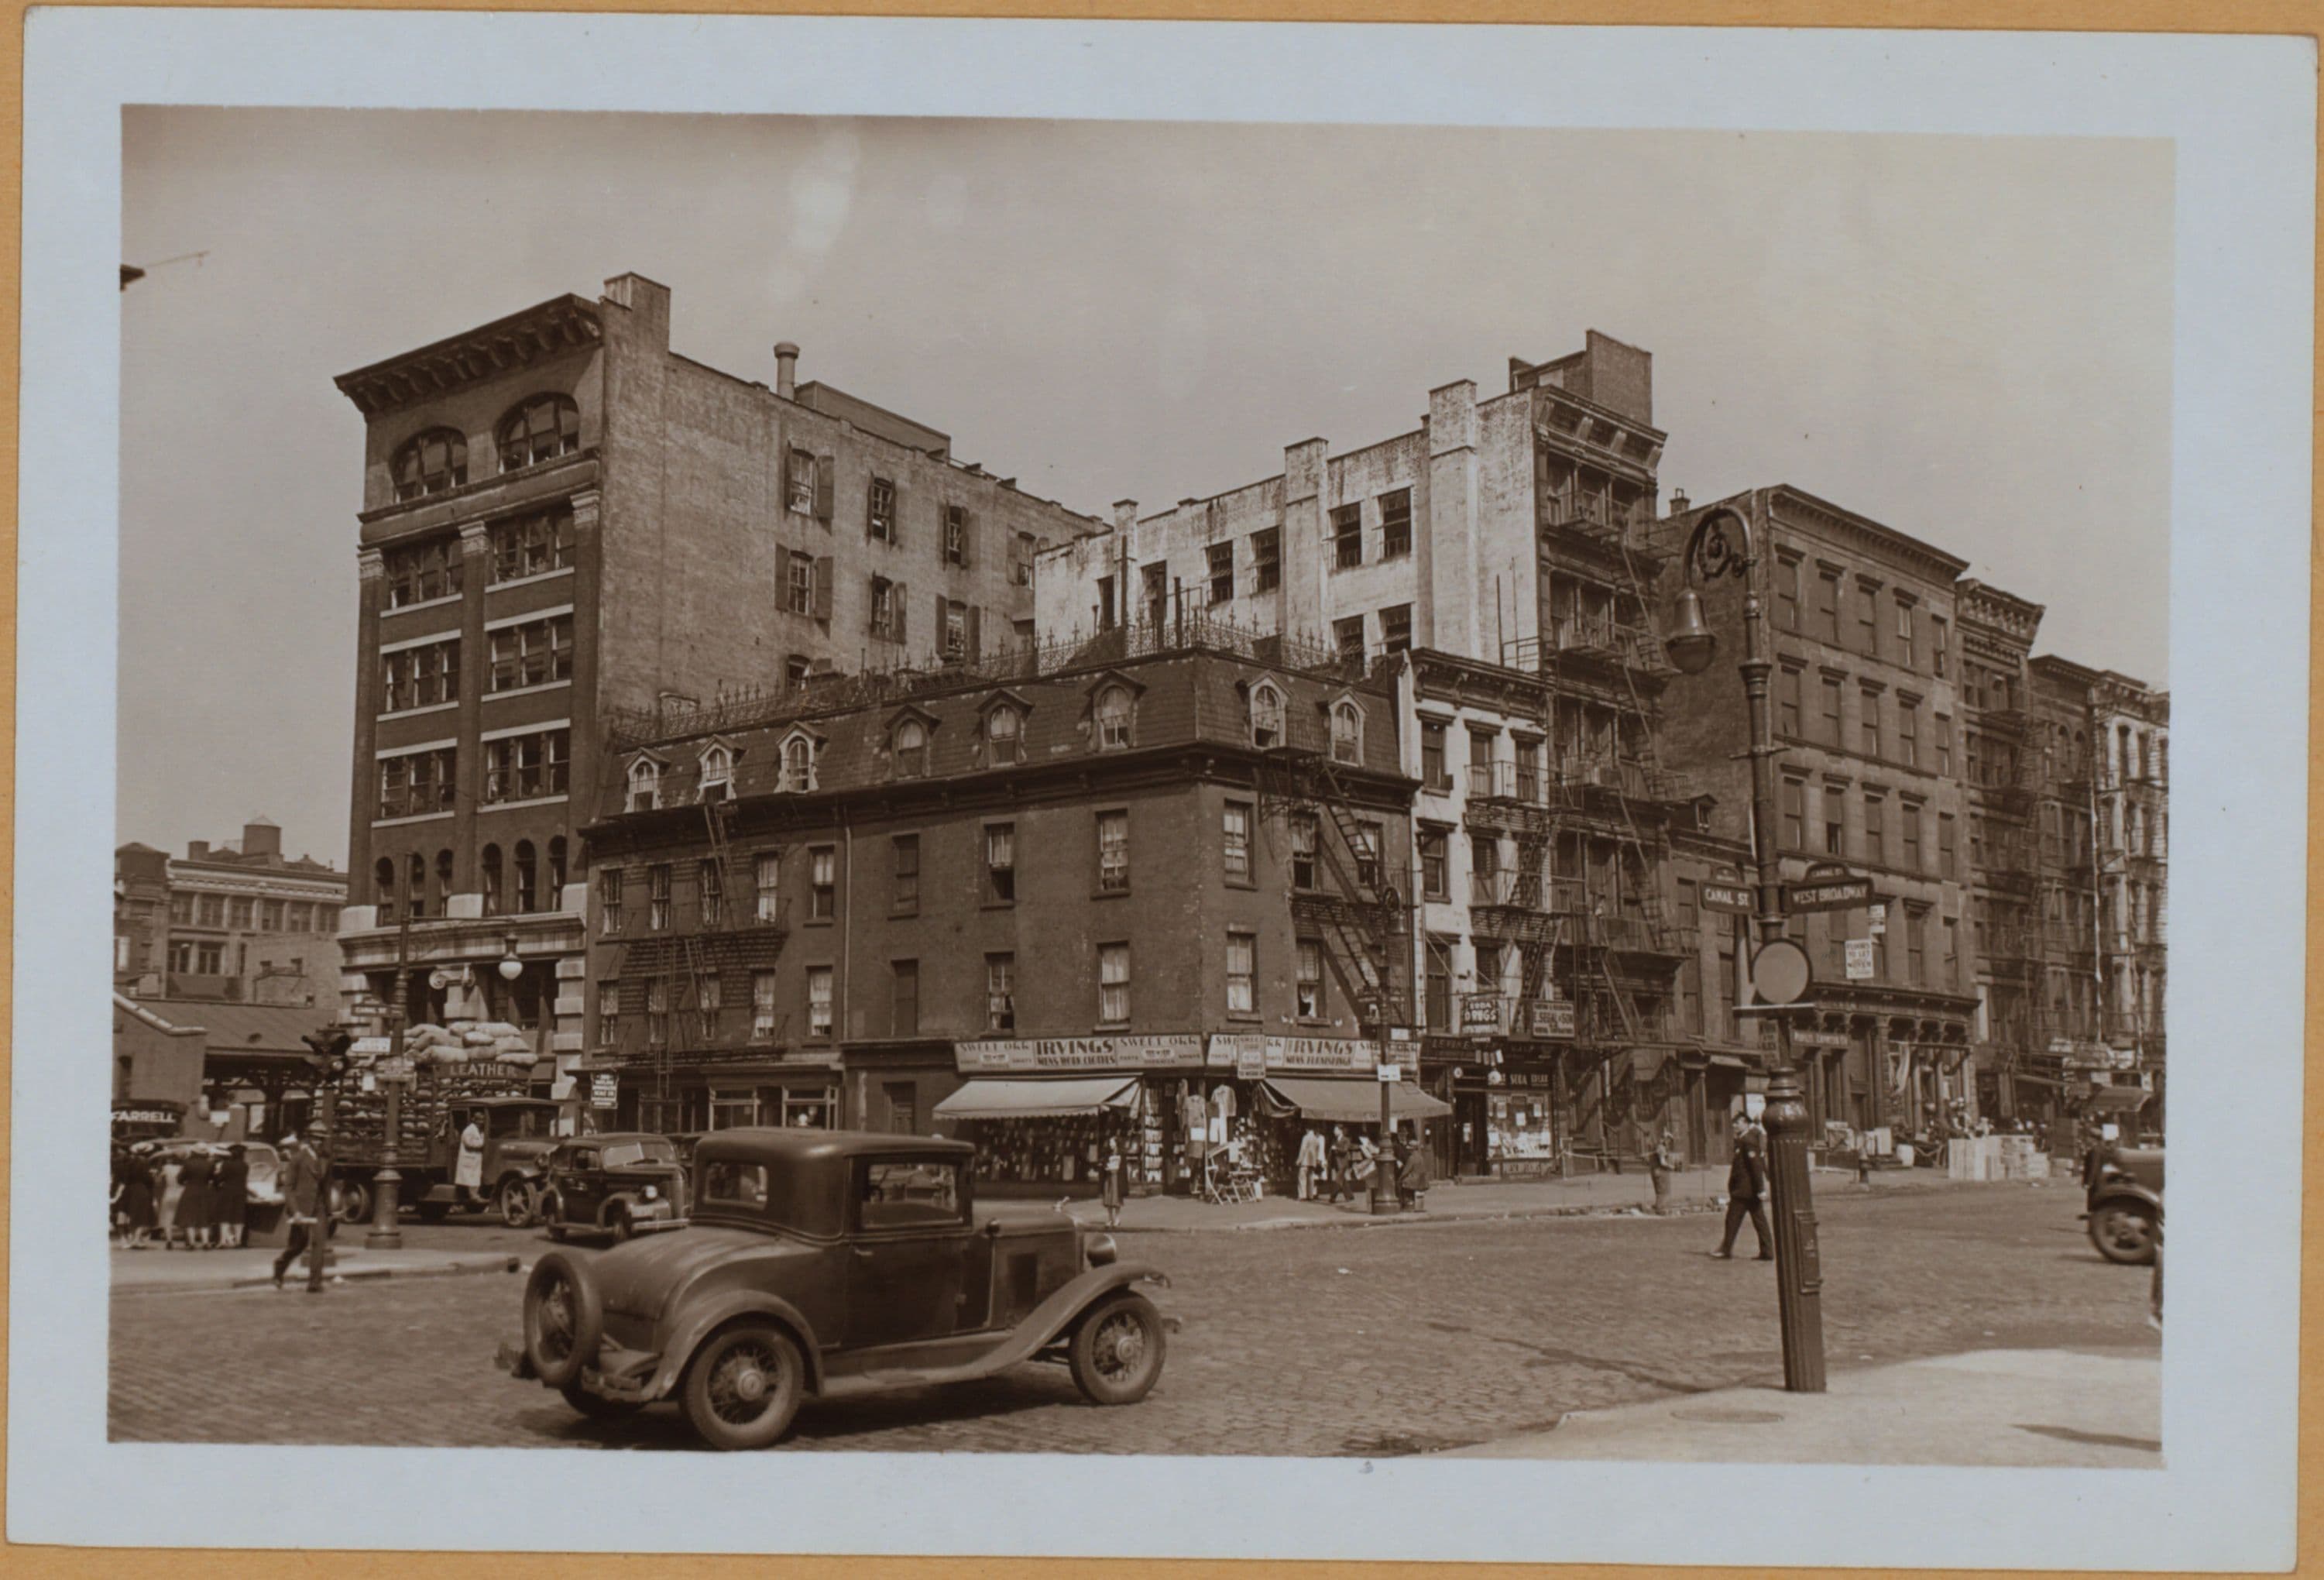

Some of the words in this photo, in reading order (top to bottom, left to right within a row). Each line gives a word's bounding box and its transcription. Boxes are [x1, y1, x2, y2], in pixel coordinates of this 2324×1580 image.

[1704, 888, 1734, 905] CANAL
[1792, 891, 1817, 905] WEST
[1818, 885, 1867, 902] BROADWAY
[1464, 1010, 1496, 1022] DRUGS
[1037, 1039, 1113, 1055] IRVINGS
[1288, 1040, 1353, 1054] IRVINGS
[450, 1063, 517, 1077] LEATHER
